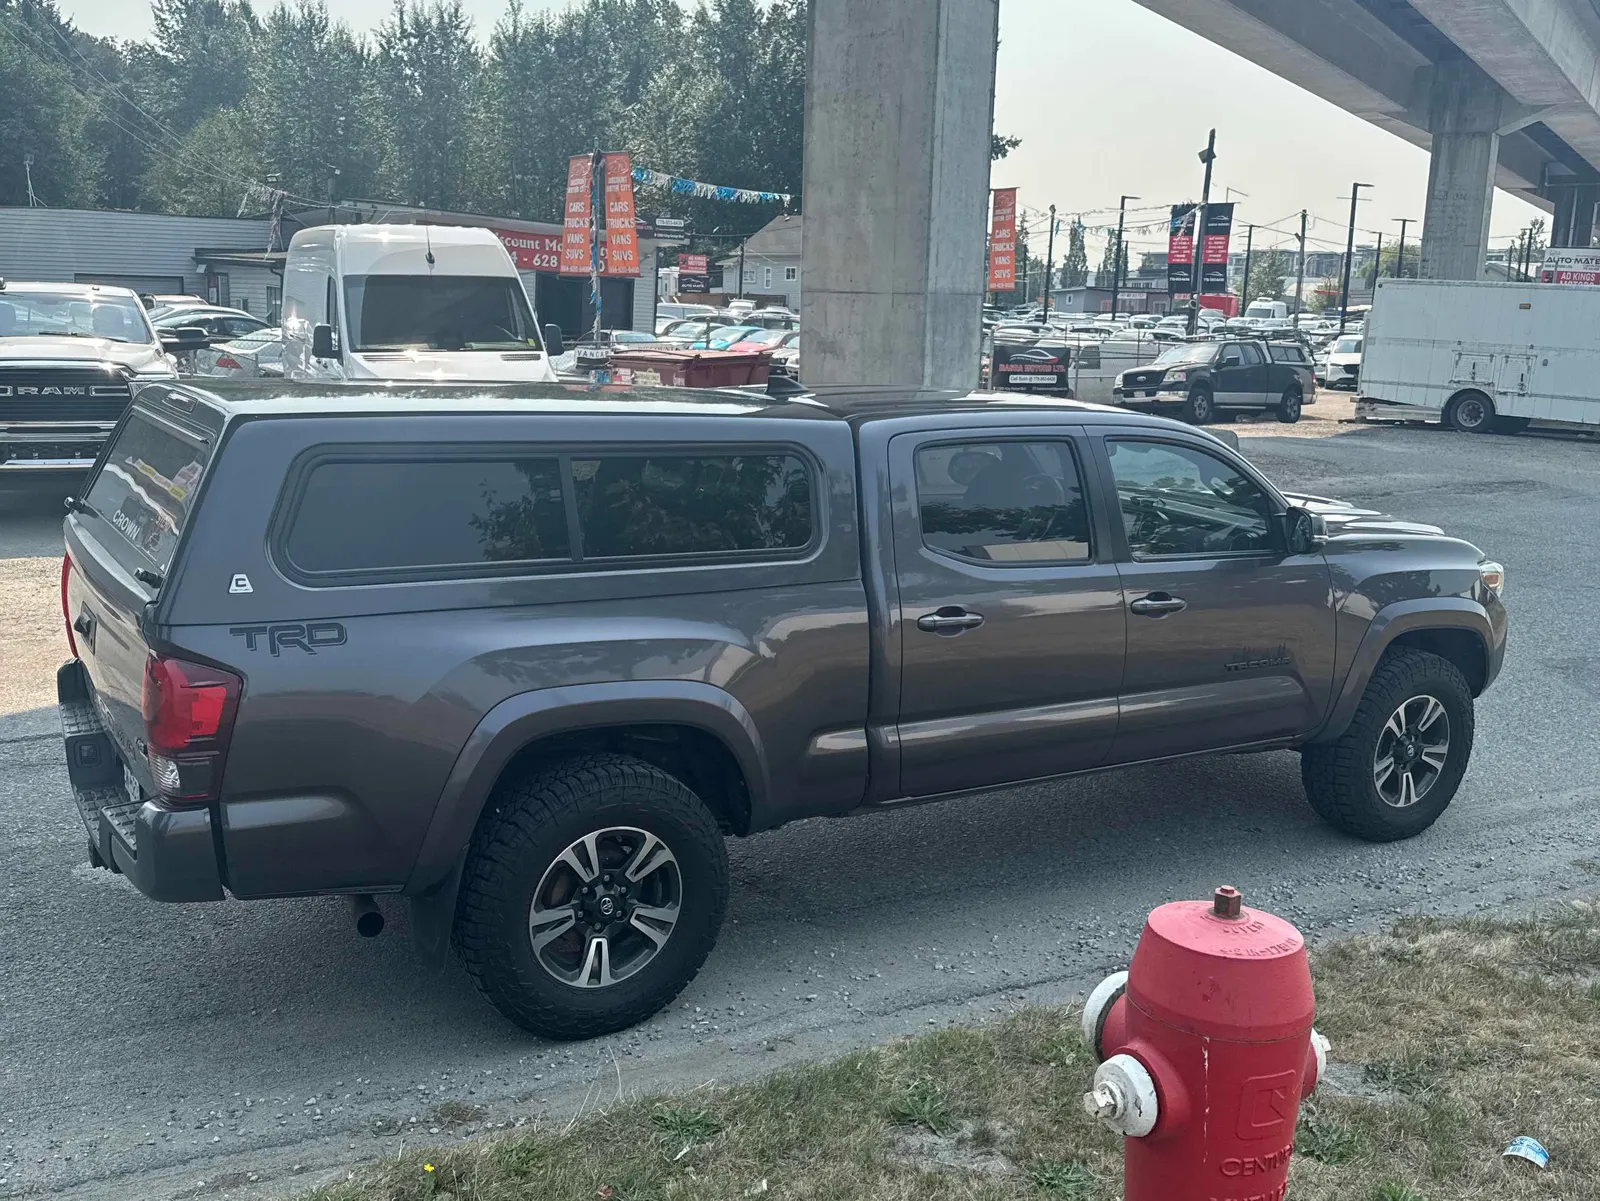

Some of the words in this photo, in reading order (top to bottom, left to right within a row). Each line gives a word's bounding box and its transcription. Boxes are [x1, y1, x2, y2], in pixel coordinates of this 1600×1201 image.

[569, 202, 585, 212] CARS
[610, 202, 628, 212] CARS
[564, 218, 590, 228] TRUCKS
[606, 218, 635, 229] TRUCKS
[995, 229, 1010, 238] CARS
[567, 234, 584, 244] VANS
[612, 234, 631, 245] VANS
[992, 243, 1015, 252] TRUCKS
[566, 249, 584, 259] SUVS
[612, 250, 633, 261] SUVS
[533, 254, 558, 267] 628
[995, 256, 1010, 265] VANS
[994, 270, 1010, 279] SUVS
[1561, 272, 1571, 280] AD
[1573, 273, 1596, 281] KINGS
[17, 386, 85, 394] RAM
[112, 510, 140, 540] CROWN
[229, 622, 348, 658] TRD
